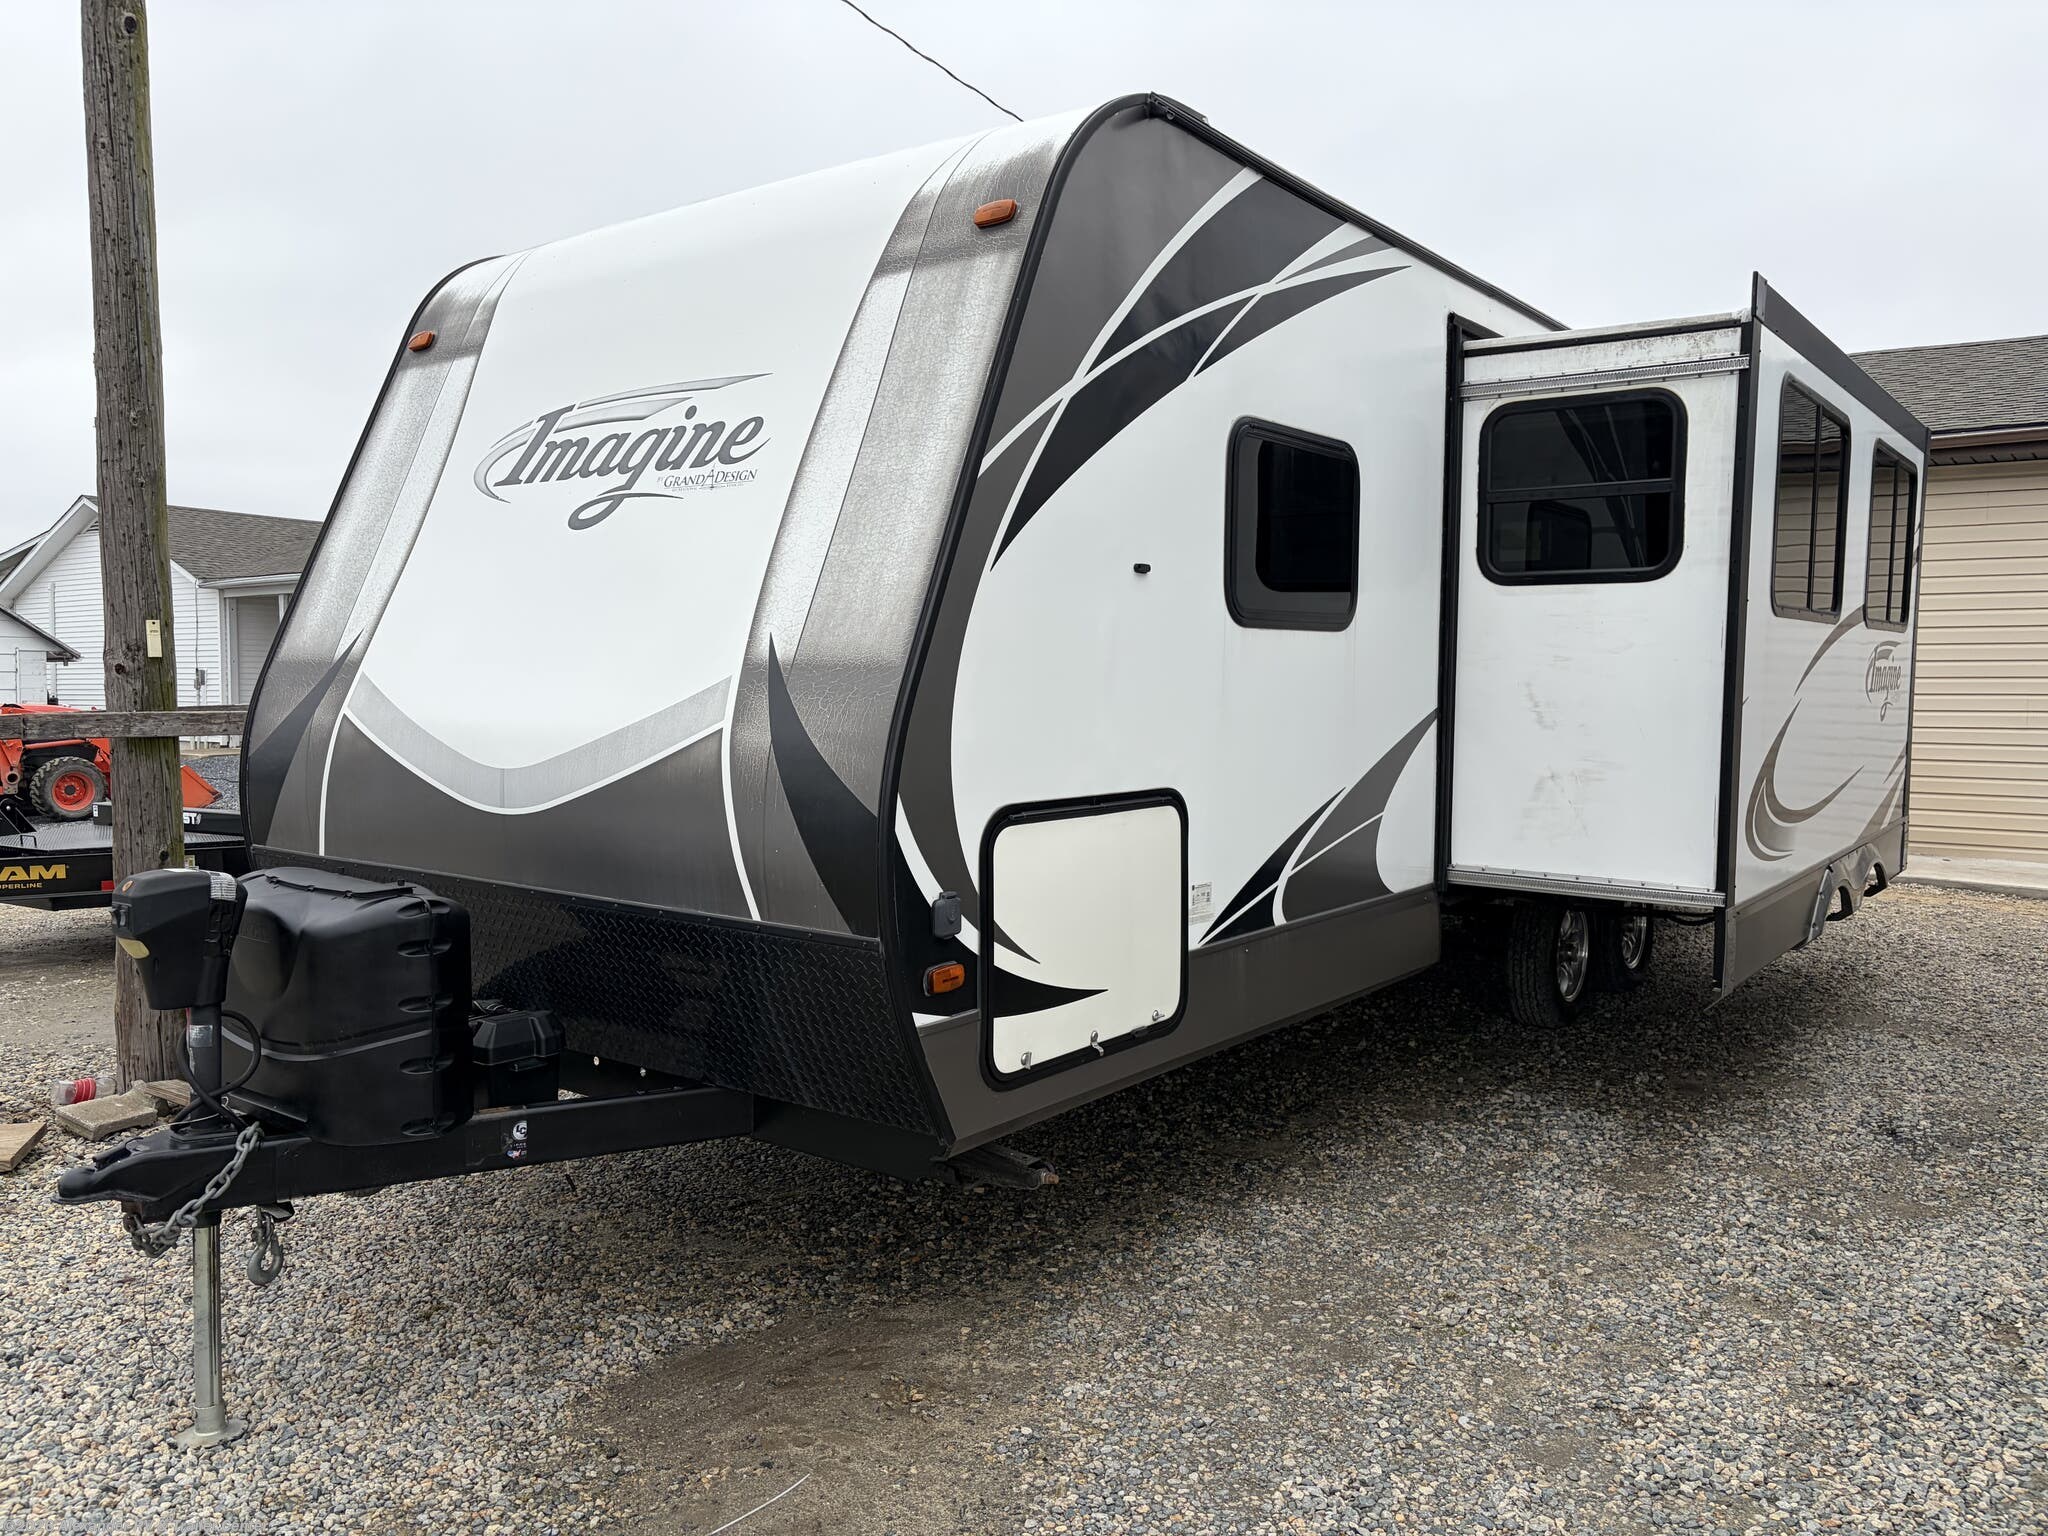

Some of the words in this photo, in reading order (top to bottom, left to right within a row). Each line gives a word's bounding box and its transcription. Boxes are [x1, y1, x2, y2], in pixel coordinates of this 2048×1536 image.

[493, 402, 771, 530] Imagine
[1868, 643, 1902, 722] Imagine
[0, 882, 43, 890] PERLINE
